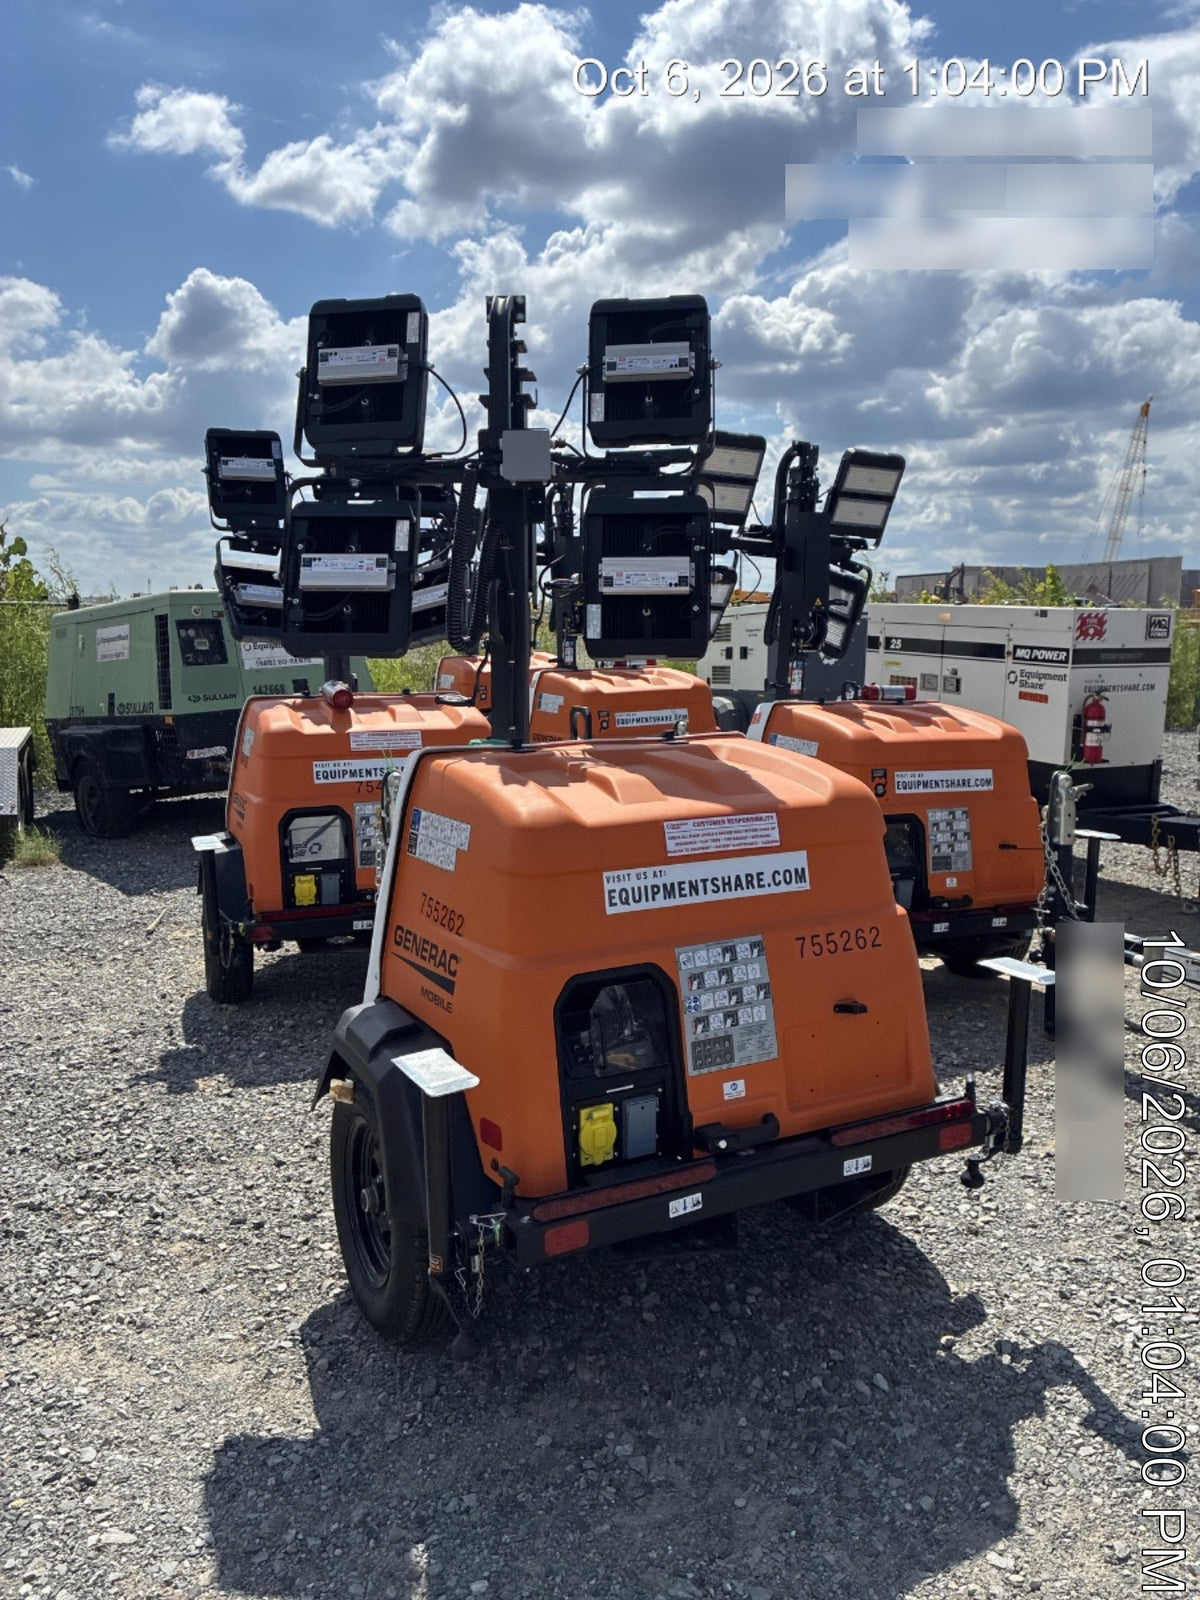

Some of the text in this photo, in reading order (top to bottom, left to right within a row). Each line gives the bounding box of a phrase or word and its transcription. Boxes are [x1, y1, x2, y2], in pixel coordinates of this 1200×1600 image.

[890, 639, 902, 649] 25
[1015, 648, 1067, 661] MQ POWER
[1020, 669, 1067, 682] Equipment
[896, 777, 992, 791] EQUIPMENTSHARE.COM
[605, 869, 667, 885] VISIT US AT:
[607, 867, 808, 908] EQUIPMENTSHARE.COM
[421, 892, 465, 938] 755262
[394, 924, 461, 978] GENERAC
[795, 926, 882, 959] 755262
[420, 985, 453, 1014] MOBILE
